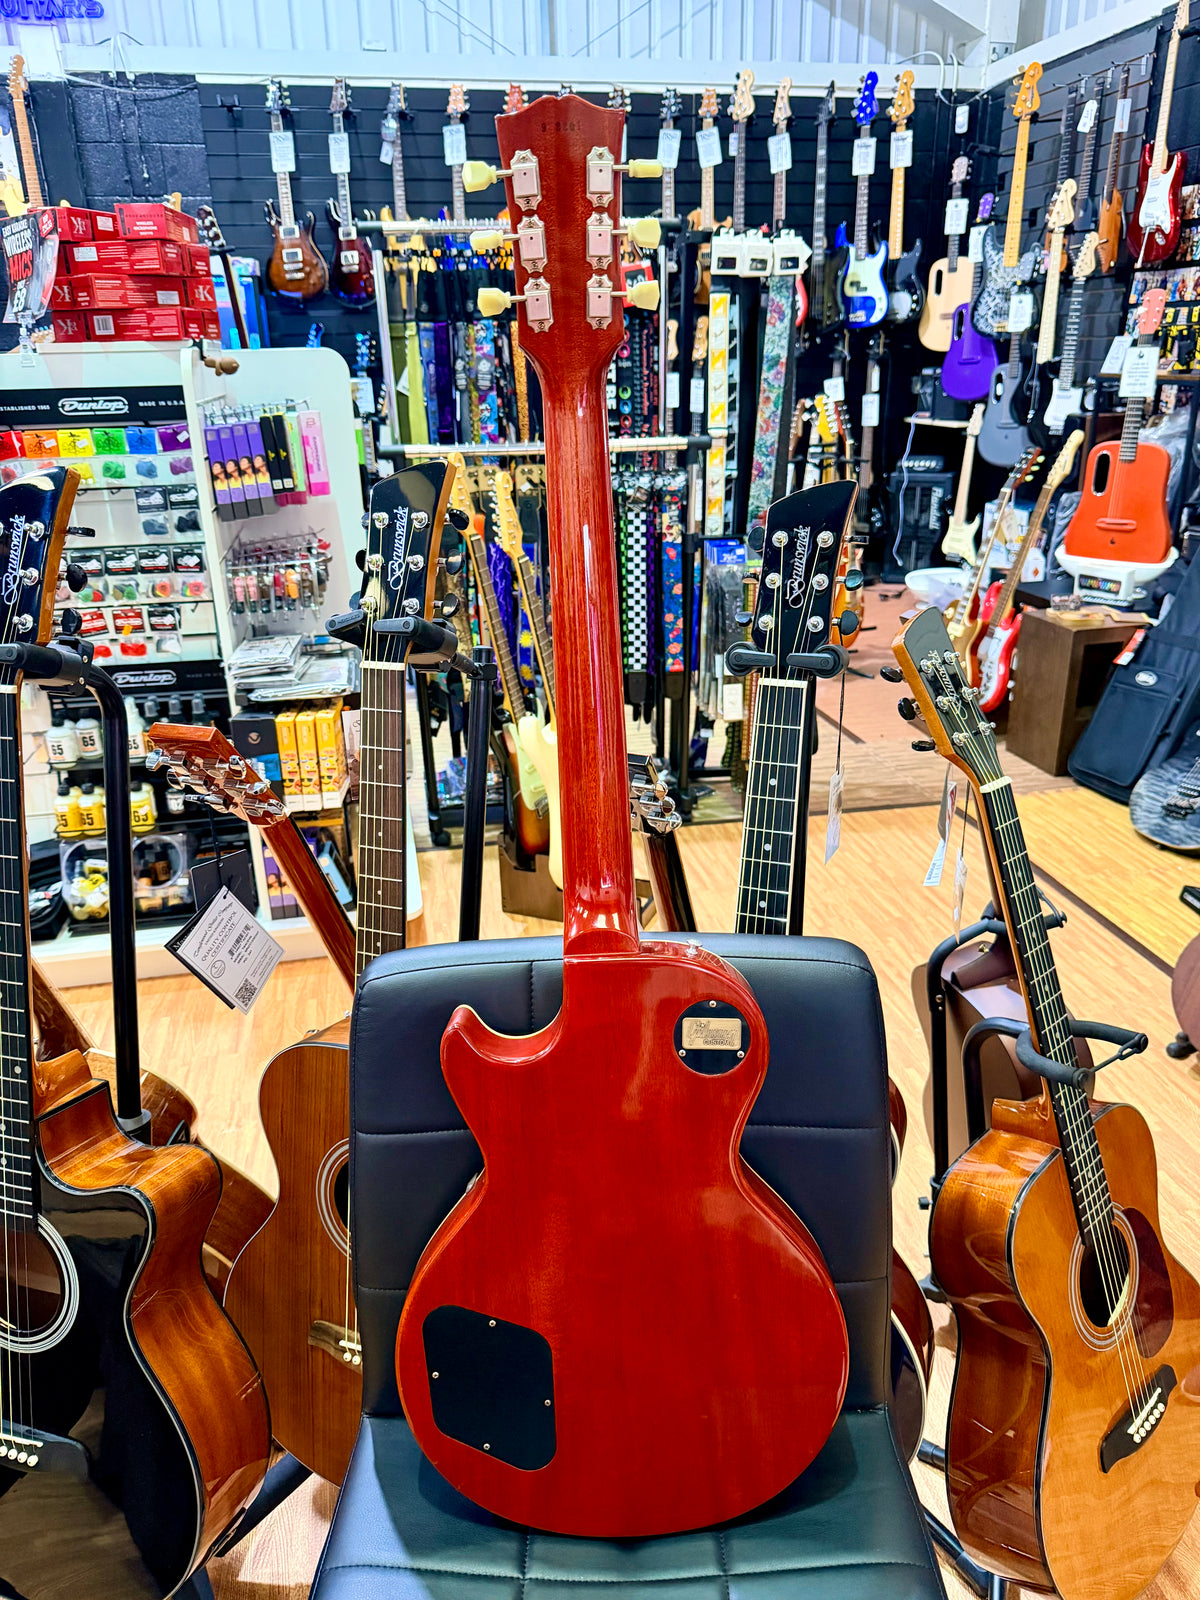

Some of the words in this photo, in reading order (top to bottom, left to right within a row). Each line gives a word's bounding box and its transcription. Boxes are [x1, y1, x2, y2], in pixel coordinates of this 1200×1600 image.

[0, 0, 104, 19] UITARS
[3, 228, 33, 258] WIRELESS
[9, 249, 33, 284] MICS
[12, 287, 27, 313] £8
[62, 399, 126, 413] Dunlop
[1, 514, 26, 605] Brunswick
[387, 505, 409, 590] Brunswick
[785, 525, 811, 609] Brunswick
[116, 673, 175, 684] Dunlop
[51, 744, 64, 756] 65
[82, 735, 96, 748] 65
[201, 938, 217, 962] QUALITY
[218, 911, 237, 937] CONTROL
[210, 922, 237, 958] CERTIFICATE
[703, 1038, 731, 1046] CUSTOM
